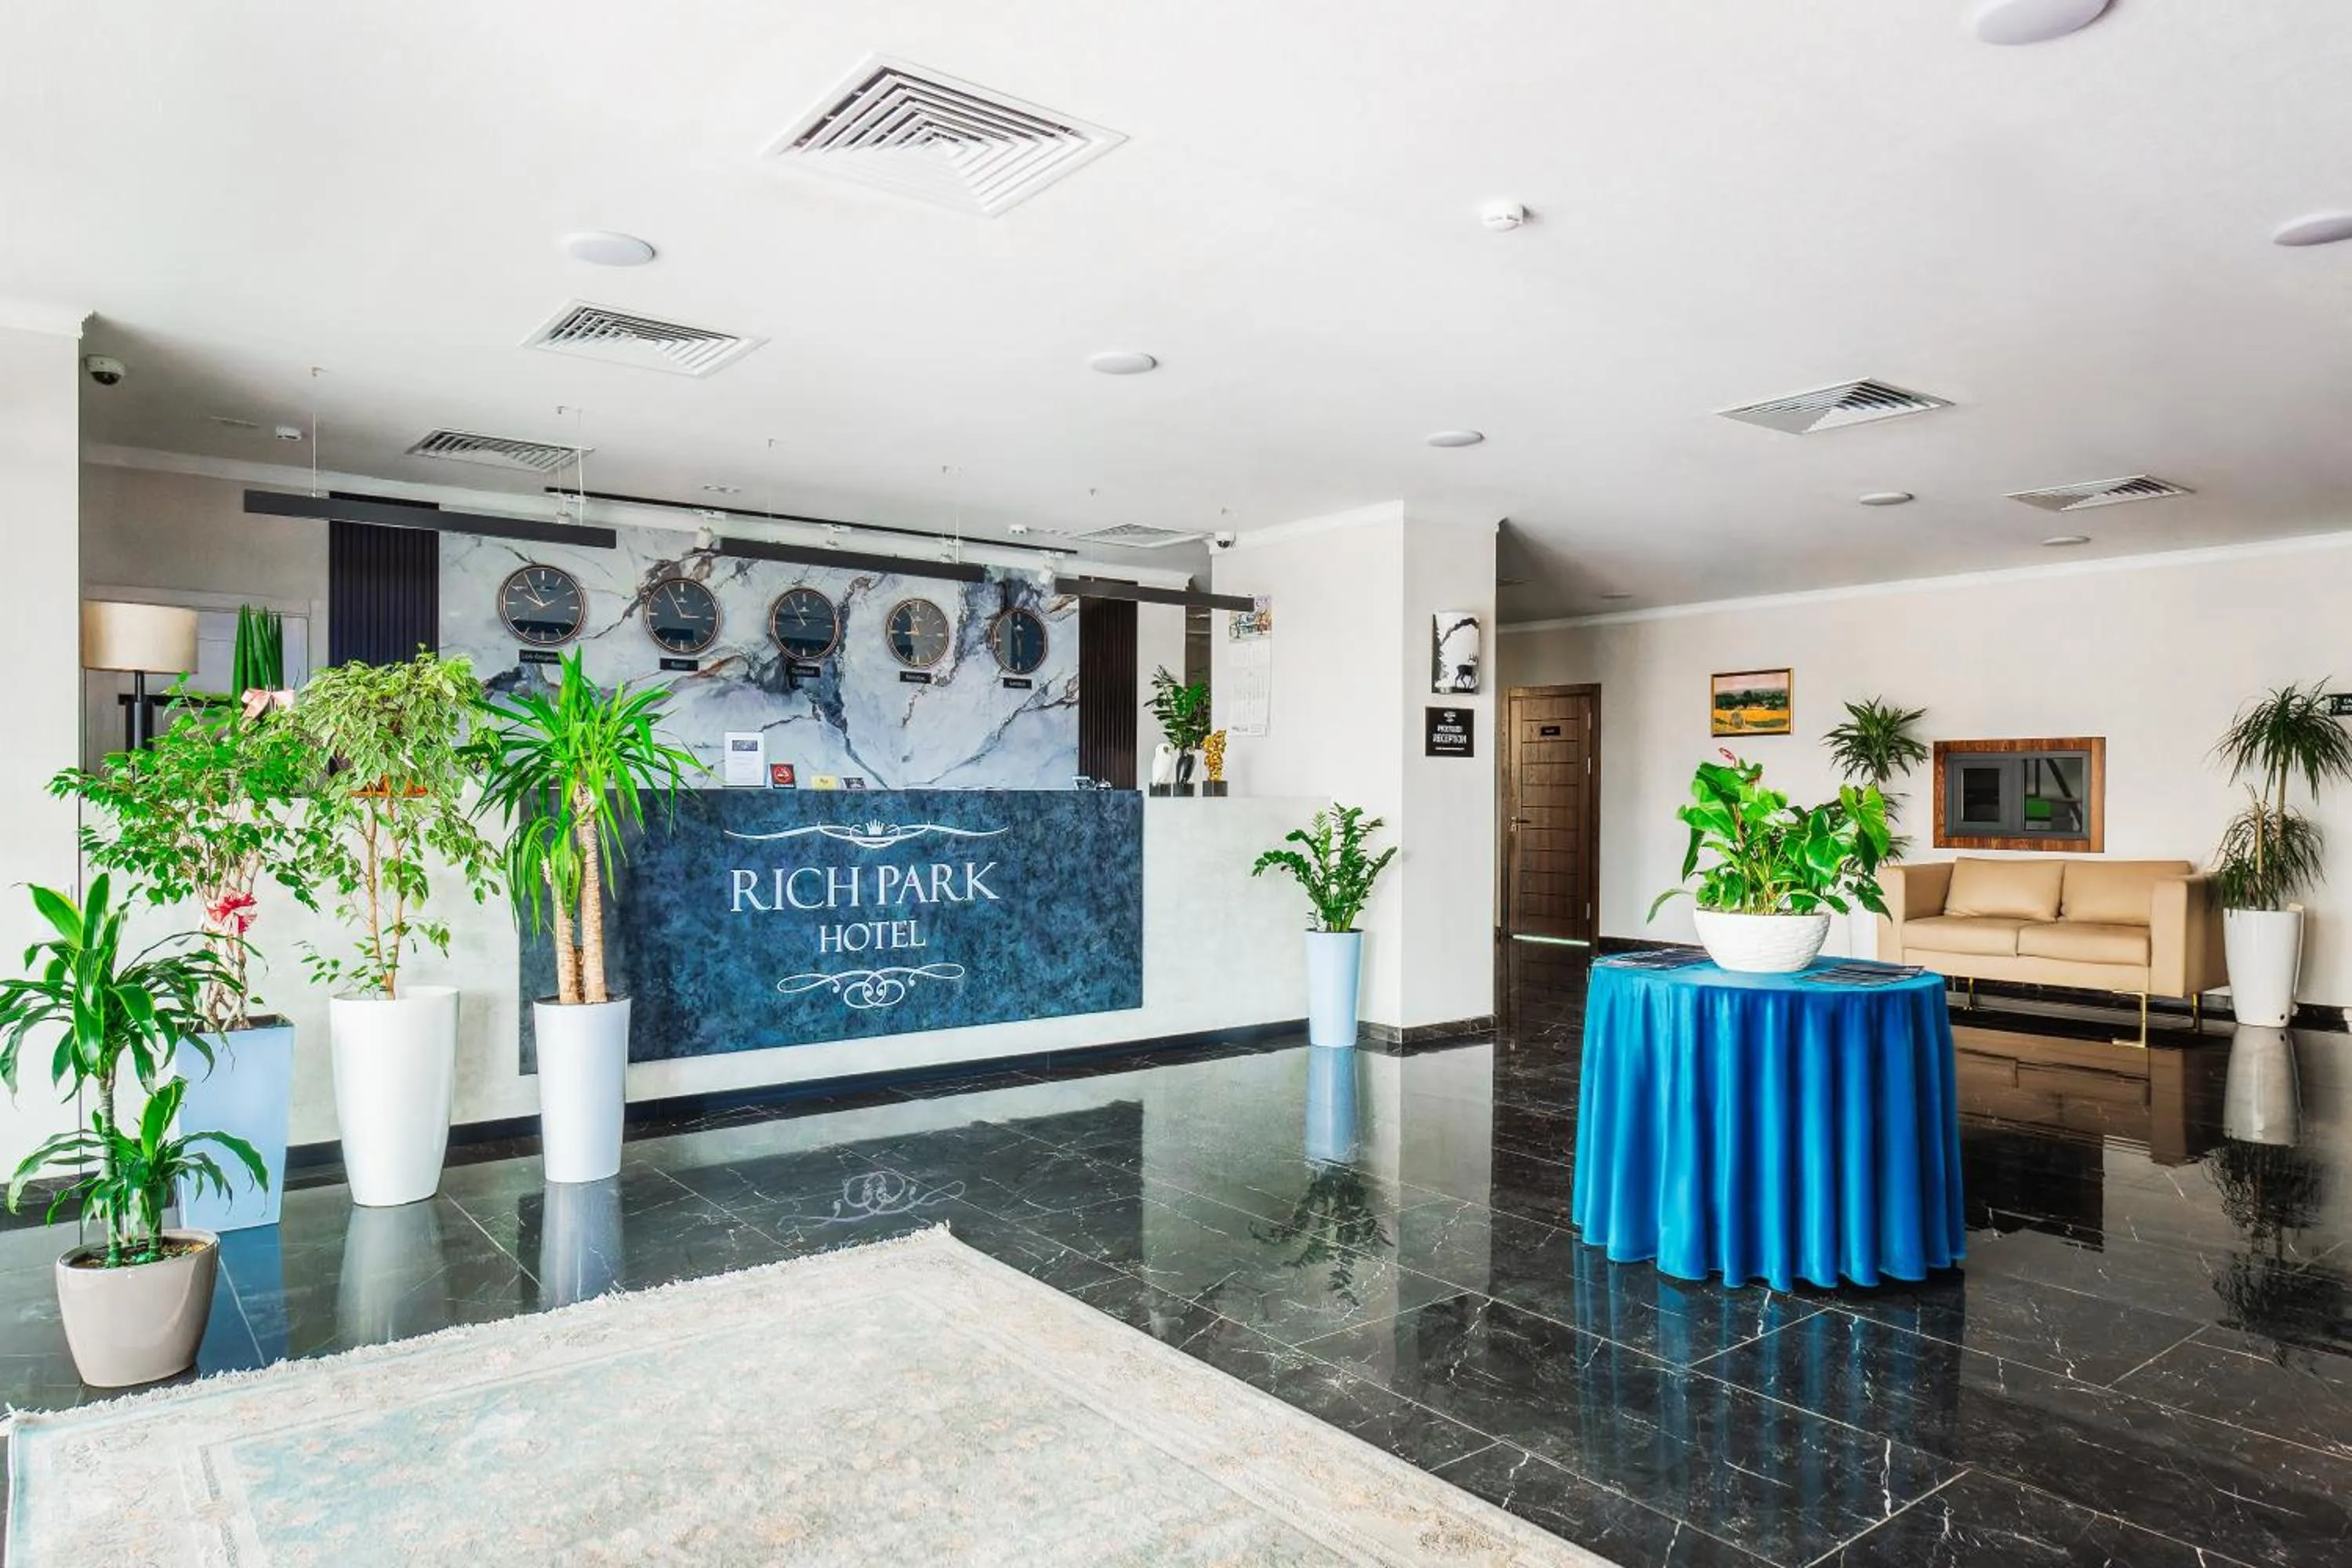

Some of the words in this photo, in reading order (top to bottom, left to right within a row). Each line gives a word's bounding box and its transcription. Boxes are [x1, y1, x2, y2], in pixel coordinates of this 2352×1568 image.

[730, 866, 862, 912] RICH
[877, 862, 1001, 906] PARK
[820, 920, 926, 953] HOTEL
